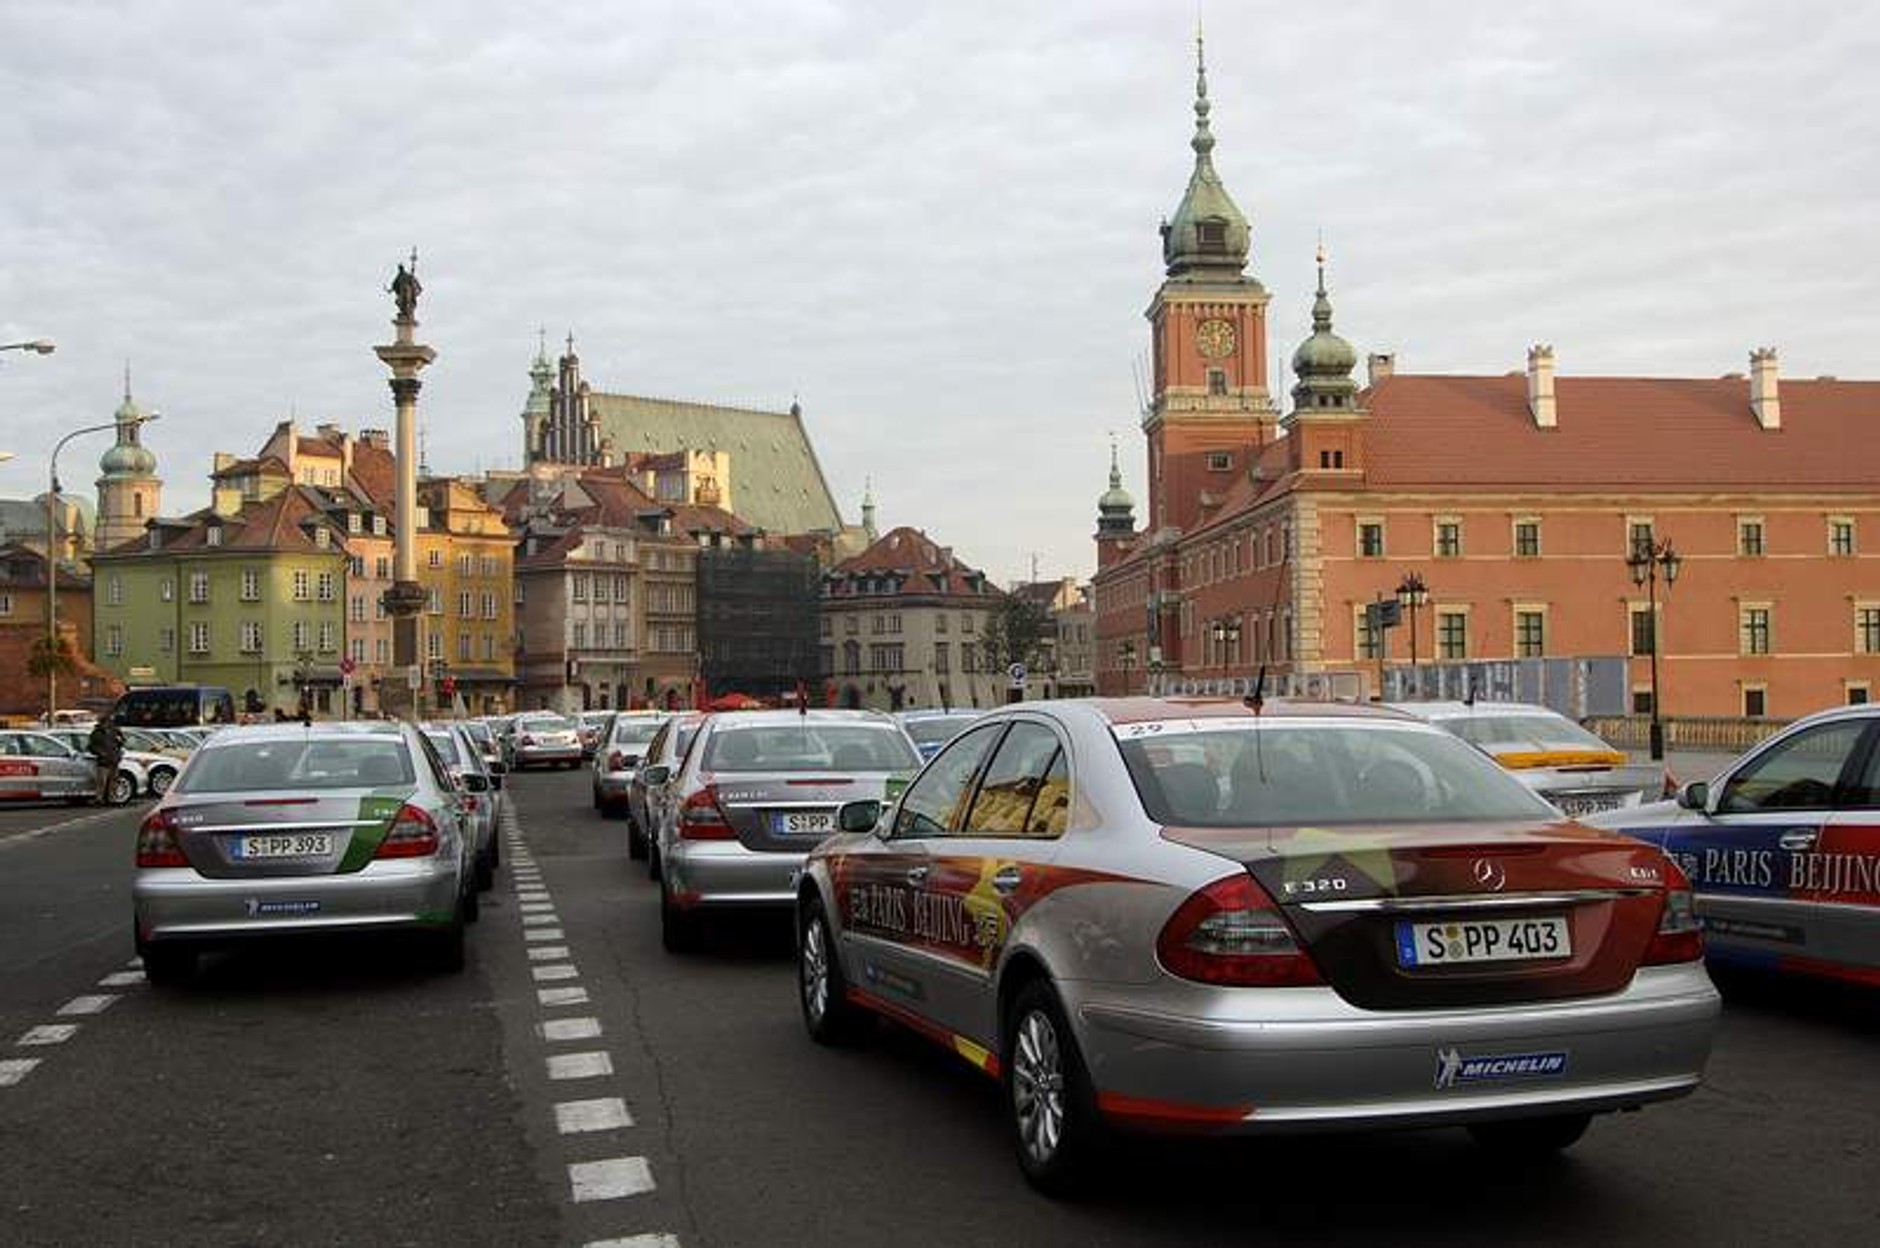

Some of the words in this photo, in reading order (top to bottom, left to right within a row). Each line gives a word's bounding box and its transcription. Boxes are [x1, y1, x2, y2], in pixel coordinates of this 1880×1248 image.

[789, 815, 799, 831] S
[809, 815, 829, 830] PP
[248, 838, 260, 855] S
[270, 838, 291, 854] PP
[295, 836, 326, 852] 393
[1704, 848, 1772, 887] PARIS
[1283, 882, 1299, 894] E
[1301, 879, 1346, 893] 320
[871, 883, 906, 932] PARIS
[914, 890, 970, 946] BEIJING
[1426, 926, 1446, 959] S
[1464, 924, 1499, 957] PP
[1508, 922, 1558, 954] 403
[1463, 1057, 1562, 1076] MICHELIN
